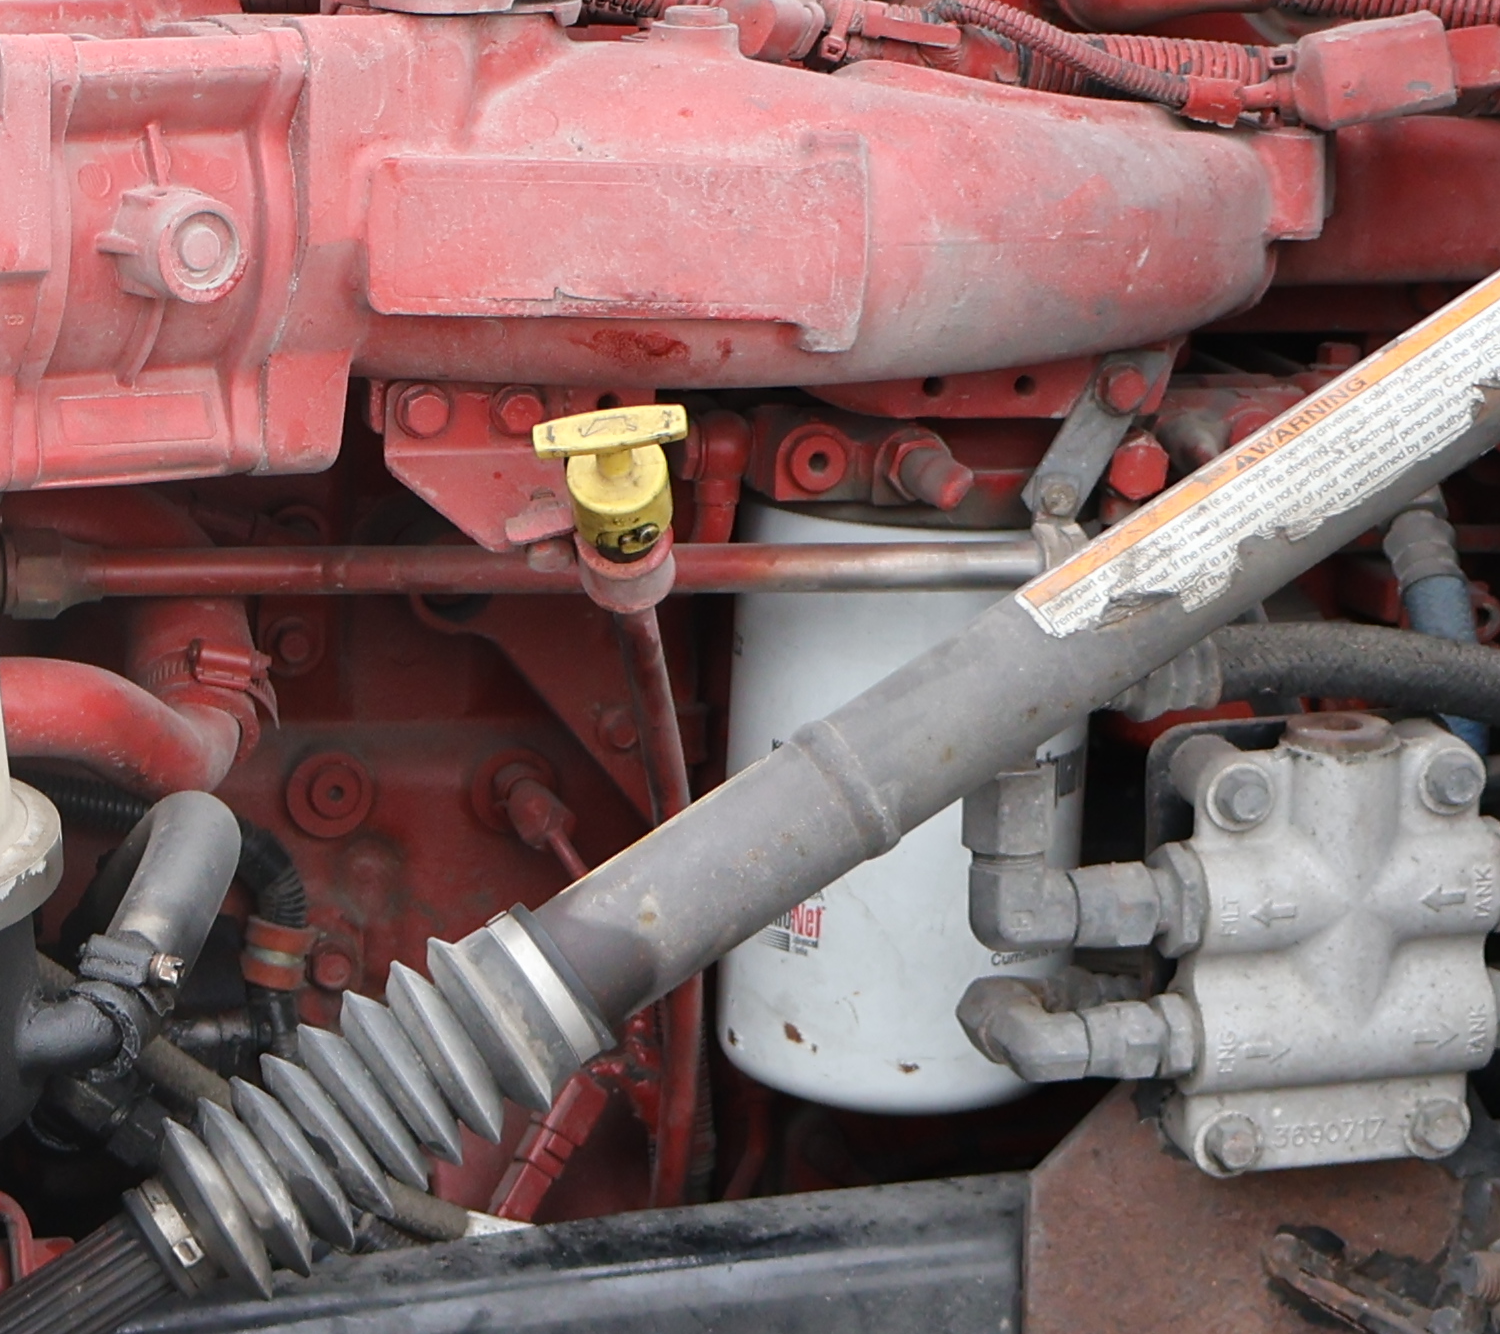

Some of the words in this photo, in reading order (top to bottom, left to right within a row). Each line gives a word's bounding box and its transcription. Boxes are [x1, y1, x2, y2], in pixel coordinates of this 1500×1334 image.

[1170, 559, 1181, 571] If
[1179, 547, 1199, 565] the
[1197, 504, 1263, 553] recalibration
[1261, 497, 1275, 511] is
[1272, 485, 1293, 503] not
[1347, 411, 1402, 453] Electronic
[1399, 382, 1445, 419] Stability
[1441, 354, 1484, 389] Control
[1248, 373, 1368, 459] WARNING
[1335, 485, 1352, 500] be
[1349, 448, 1408, 492] performed
[1404, 439, 1422, 455] by
[1420, 429, 1436, 444] an
[1053, 592, 1102, 629] removed
[1244, 490, 1258, 503] or
[1256, 483, 1267, 495] if
[1264, 471, 1285, 489] the
[1283, 442, 1329, 478] steering
[1325, 423, 1358, 450] angle
[1356, 400, 1393, 428] sensor
[1393, 391, 1405, 403] is
[1450, 346, 1470, 364] the
[1073, 578, 1097, 599] part
[1095, 569, 1109, 582] of
[1272, 432, 1318, 467] steering
[1207, 554, 1220, 567] in
[1219, 549, 1229, 560] a
[1262, 499, 1302, 530] control
[1300, 490, 1315, 505] of
[1314, 476, 1341, 498] your
[1337, 448, 1378, 480] vehicle
[1375, 434, 1399, 454] and
[1397, 403, 1446, 441] personal
[1472, 864, 1493, 918] TANK
[1466, 1003, 1485, 1055] TANK
